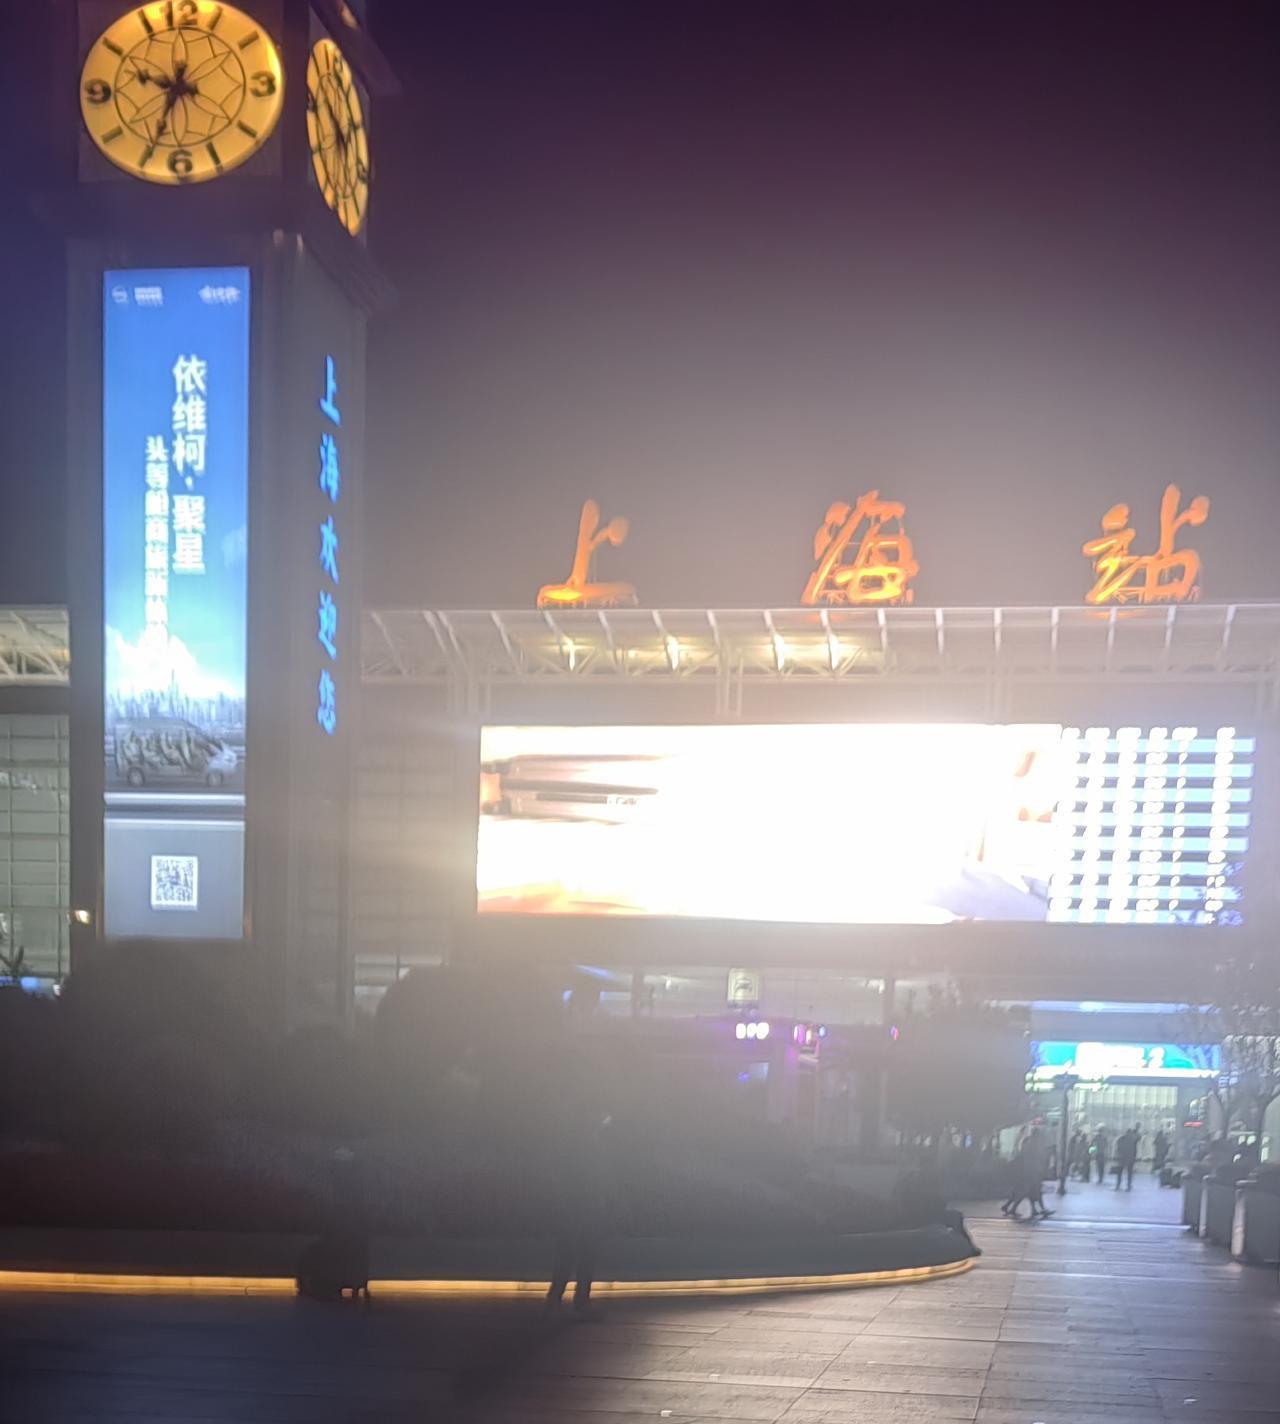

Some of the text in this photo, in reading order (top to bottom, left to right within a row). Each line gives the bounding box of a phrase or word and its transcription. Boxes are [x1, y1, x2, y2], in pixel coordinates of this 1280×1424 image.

[160, 0, 199, 29] 12
[85, 79, 112, 104] 9
[249, 70, 276, 97] 3
[167, 150, 193, 175] 6
[317, 354, 341, 736] 上海欢迎您
[537, 483, 1211, 606] 上海站
